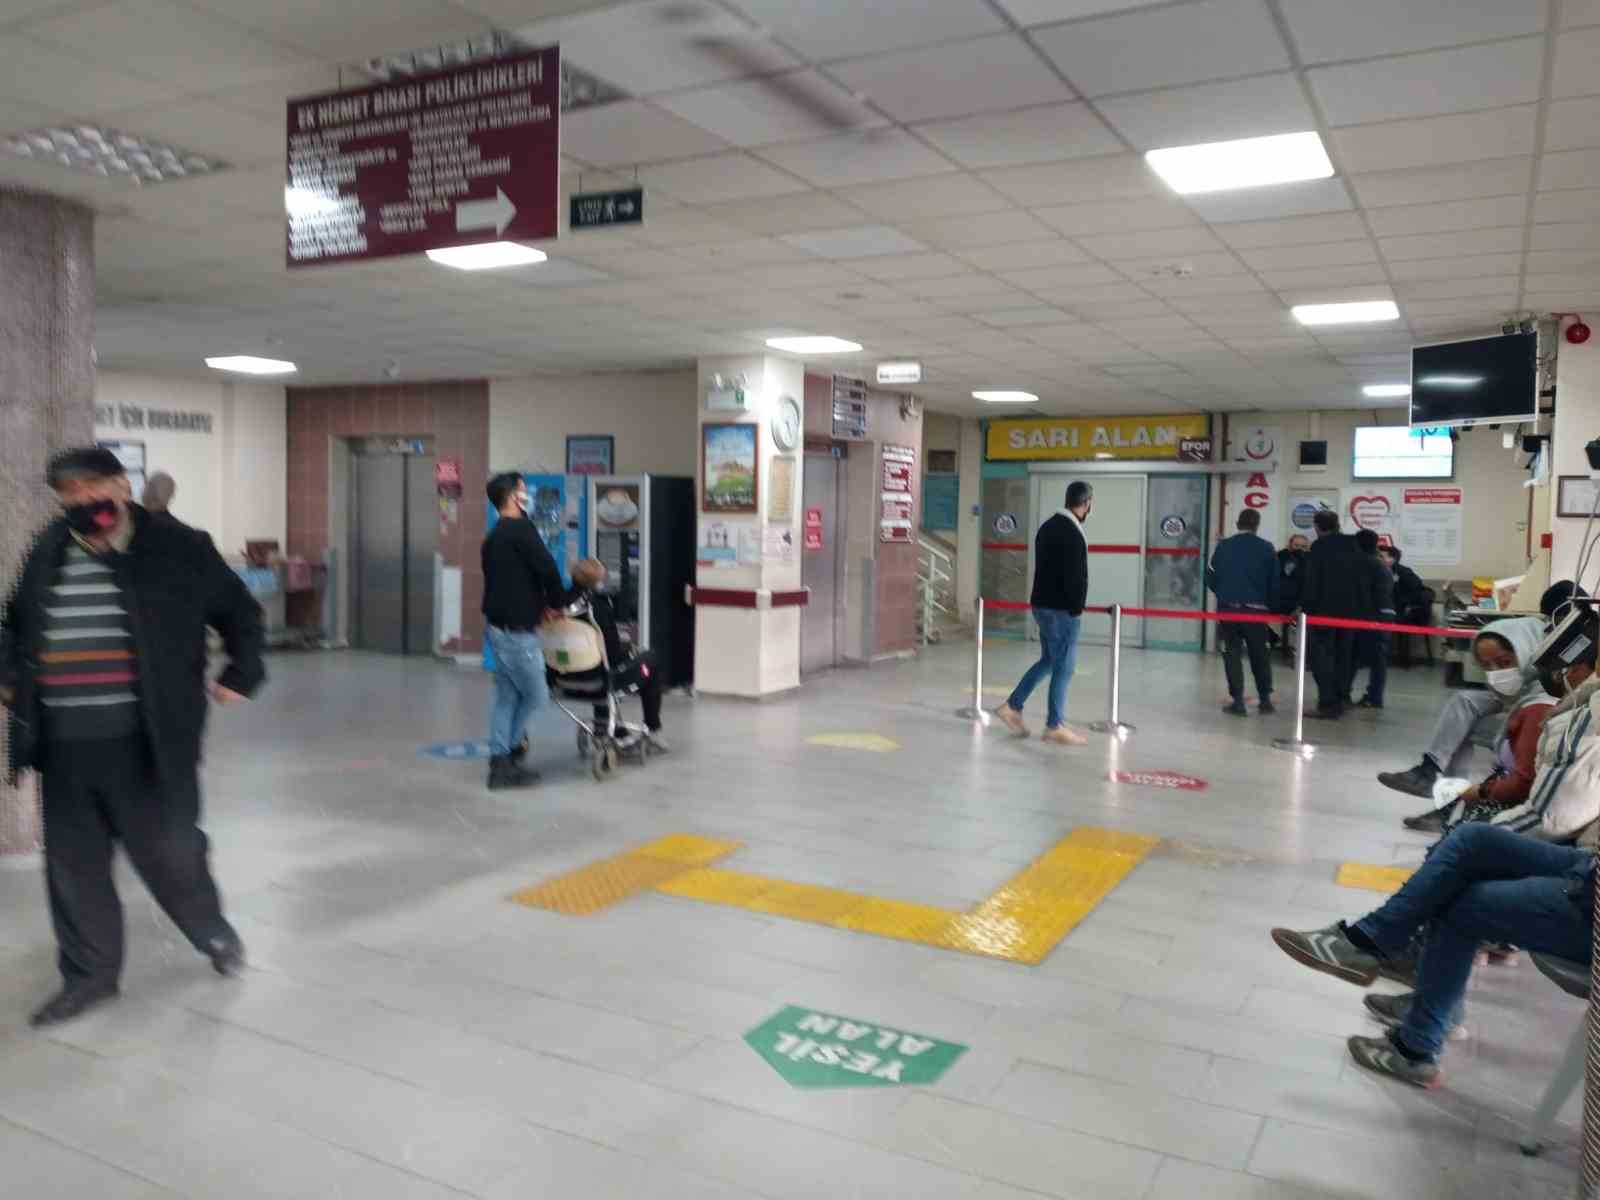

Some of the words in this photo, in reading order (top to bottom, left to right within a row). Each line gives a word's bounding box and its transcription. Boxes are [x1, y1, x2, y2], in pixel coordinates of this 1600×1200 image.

[373, 84, 421, 117] BİNASI
[1008, 427, 1078, 449] SARI
[1090, 425, 1177, 448] ALAN
[796, 1013, 936, 1057] ALAN
